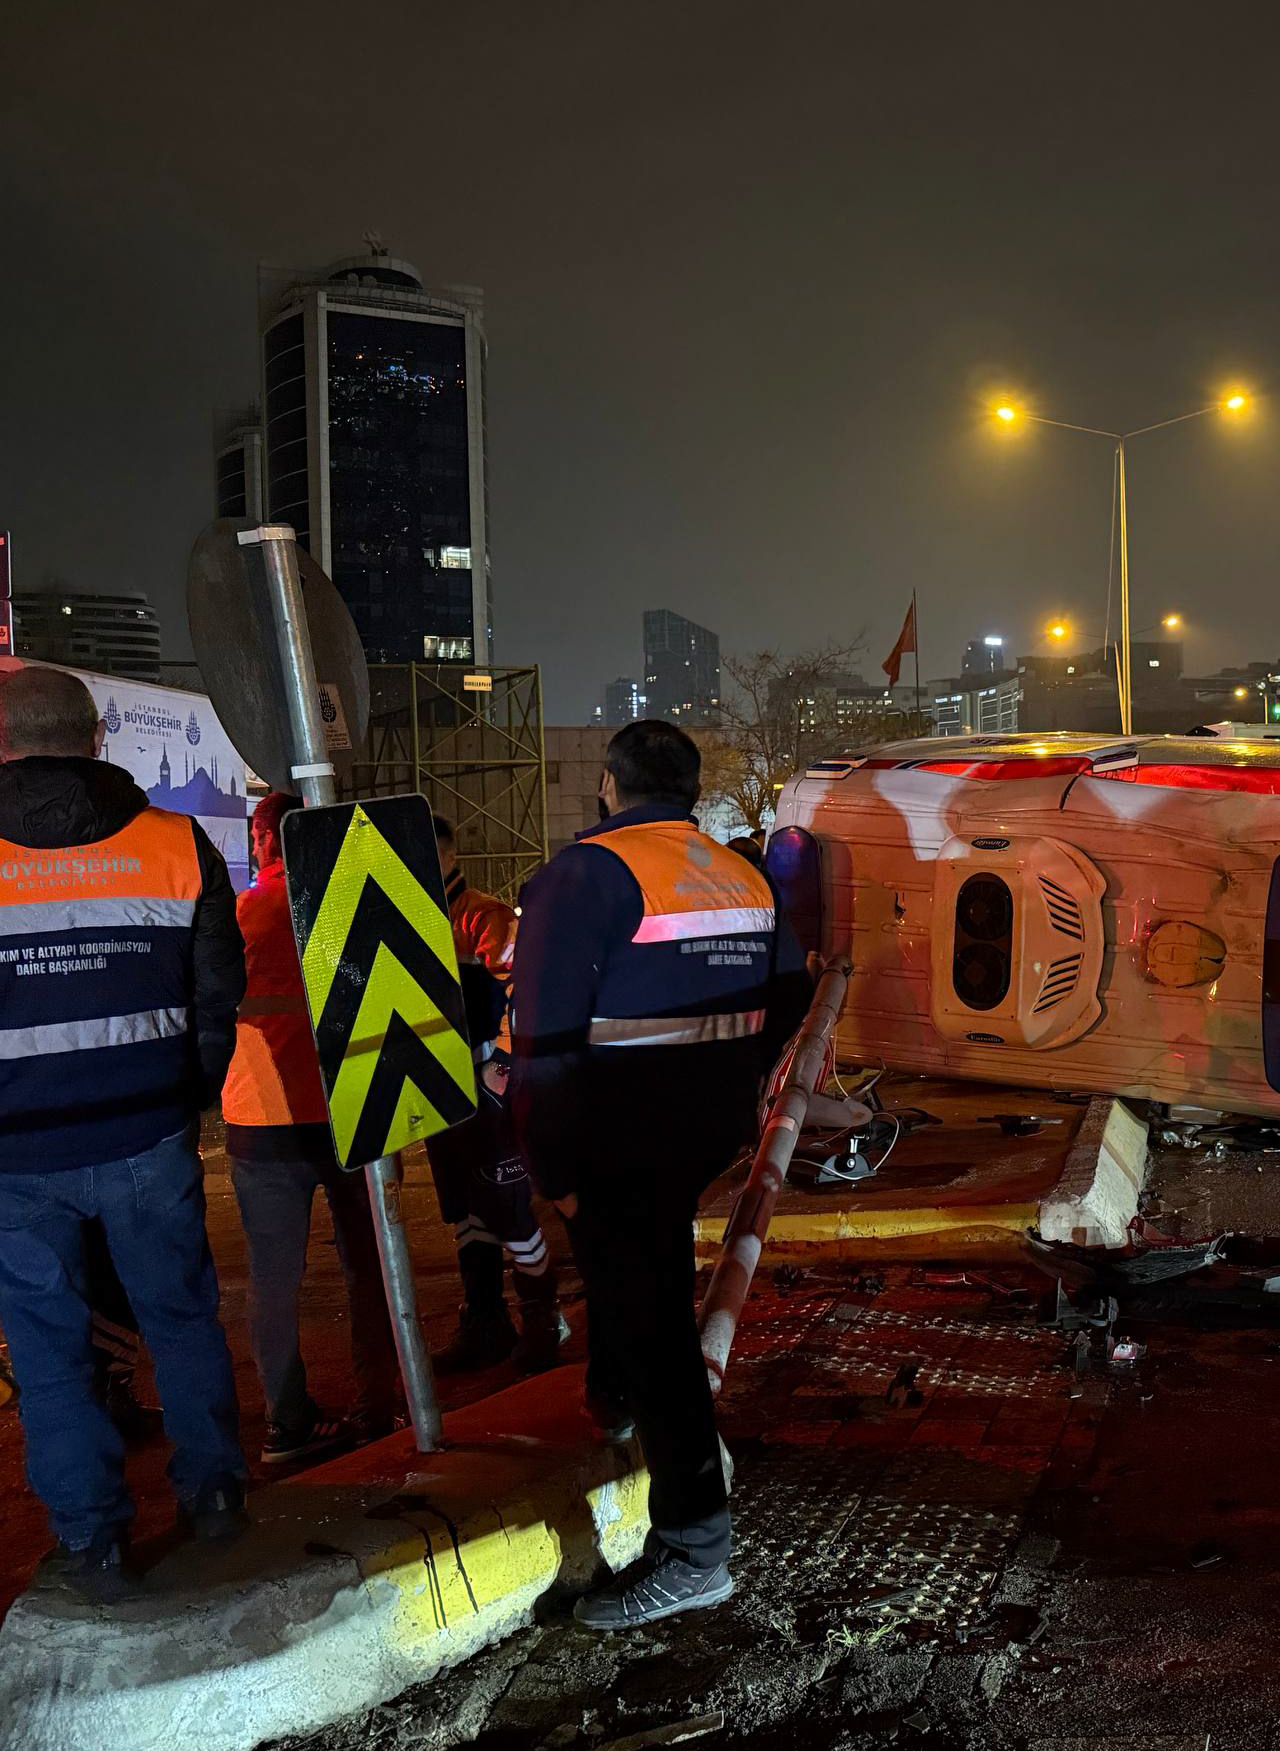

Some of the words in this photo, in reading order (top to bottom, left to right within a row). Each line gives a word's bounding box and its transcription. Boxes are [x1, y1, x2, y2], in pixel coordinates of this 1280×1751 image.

[124, 709, 182, 732] BÜYÜKŞEHİR
[133, 703, 171, 716] İSTANBUL
[0, 855, 142, 883] ÜYÜKŞEHİR
[22, 947, 35, 960] VE
[38, 944, 77, 960] ALTYAPI
[79, 938, 152, 956] KOORDİNASYON
[16, 960, 46, 977] DAİRE
[49, 955, 107, 976] BAŞKANLIĞI
